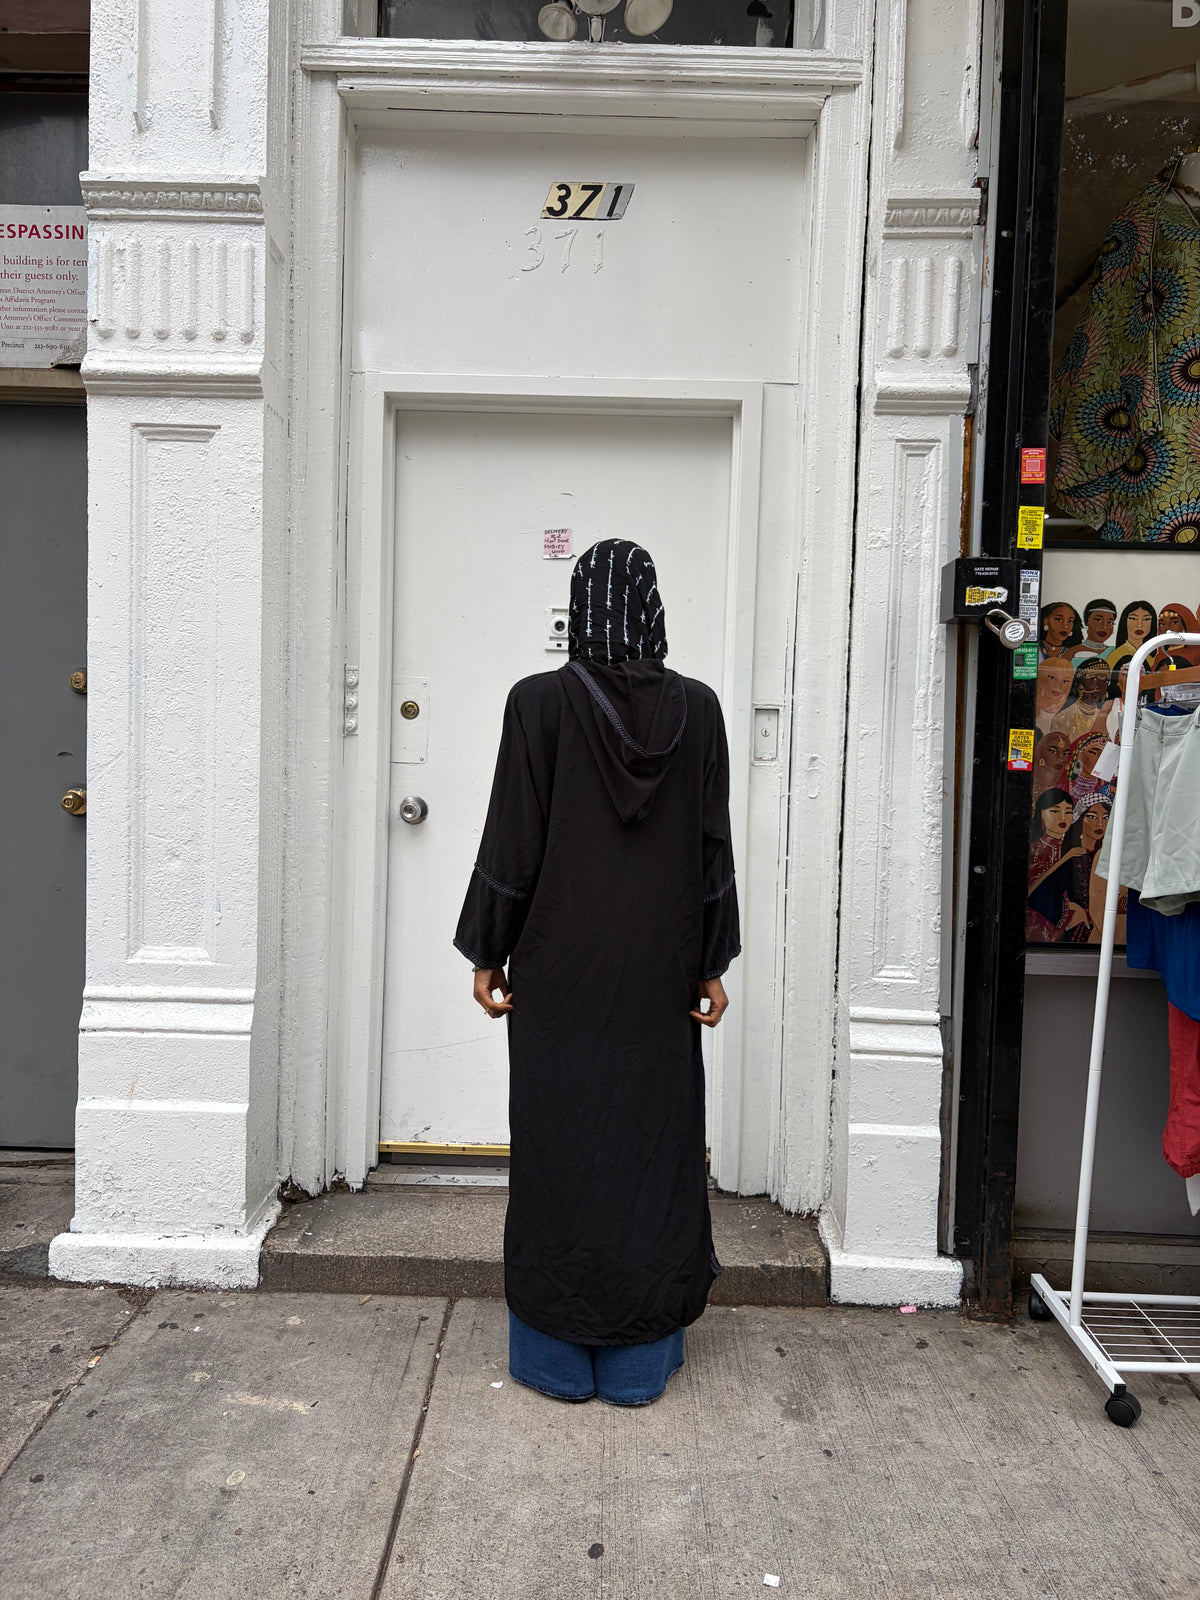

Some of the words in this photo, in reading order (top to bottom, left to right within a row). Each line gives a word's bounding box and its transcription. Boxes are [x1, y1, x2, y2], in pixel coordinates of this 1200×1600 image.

[545, 183, 624, 217] 371
[0, 223, 85, 240] ESPASSIN
[3, 255, 44, 268] building
[46, 256, 53, 266] is
[56, 255, 70, 267] for
[0, 270, 22, 280] their
[24, 272, 53, 283] guests
[55, 271, 79, 284] only.
[13, 287, 35, 295] District
[36, 288, 66, 297] Attorney's
[4, 296, 30, 304] Affidavit
[31, 297, 56, 306] Program
[13, 306, 48, 314] information
[49, 307, 69, 316] please
[3, 314, 32, 323] Attorney's
[33, 314, 52, 322] Office
[1, 323, 14, 331] Unit
[1, 341, 25, 349] Precinct
